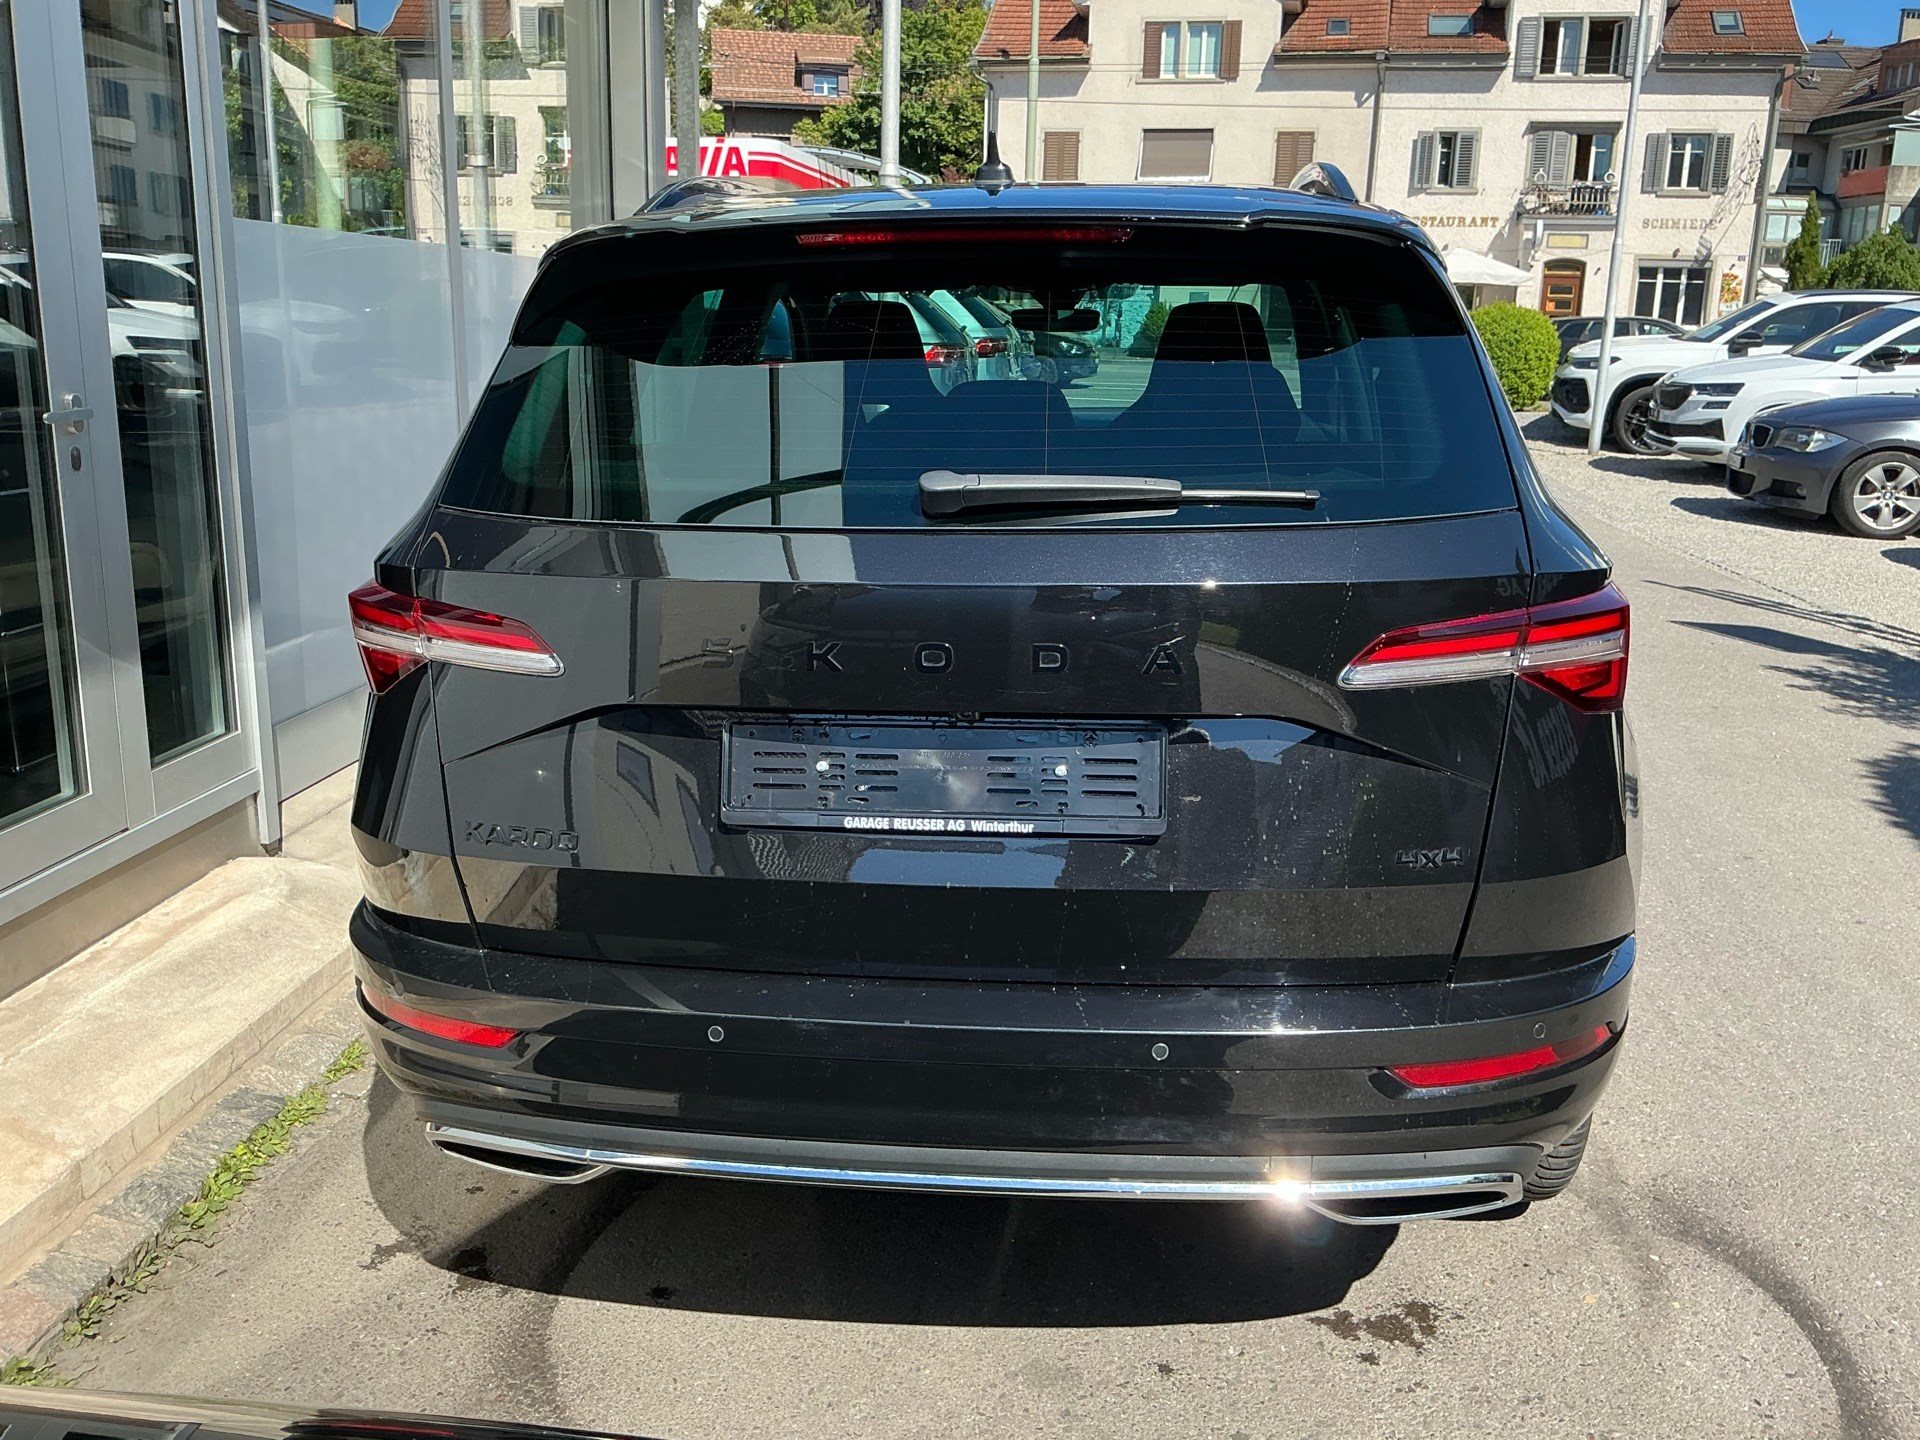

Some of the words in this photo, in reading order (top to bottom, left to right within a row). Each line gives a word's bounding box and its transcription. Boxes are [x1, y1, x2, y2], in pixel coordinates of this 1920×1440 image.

[1413, 216, 1499, 228] STAURANT
[1641, 218, 1718, 231] SCHMIEDE
[843, 816, 890, 830] GARAGE
[893, 817, 945, 832] REUSSER
[946, 819, 966, 832] AG
[970, 820, 1035, 834] Winterthur
[464, 818, 579, 853] KAROQ
